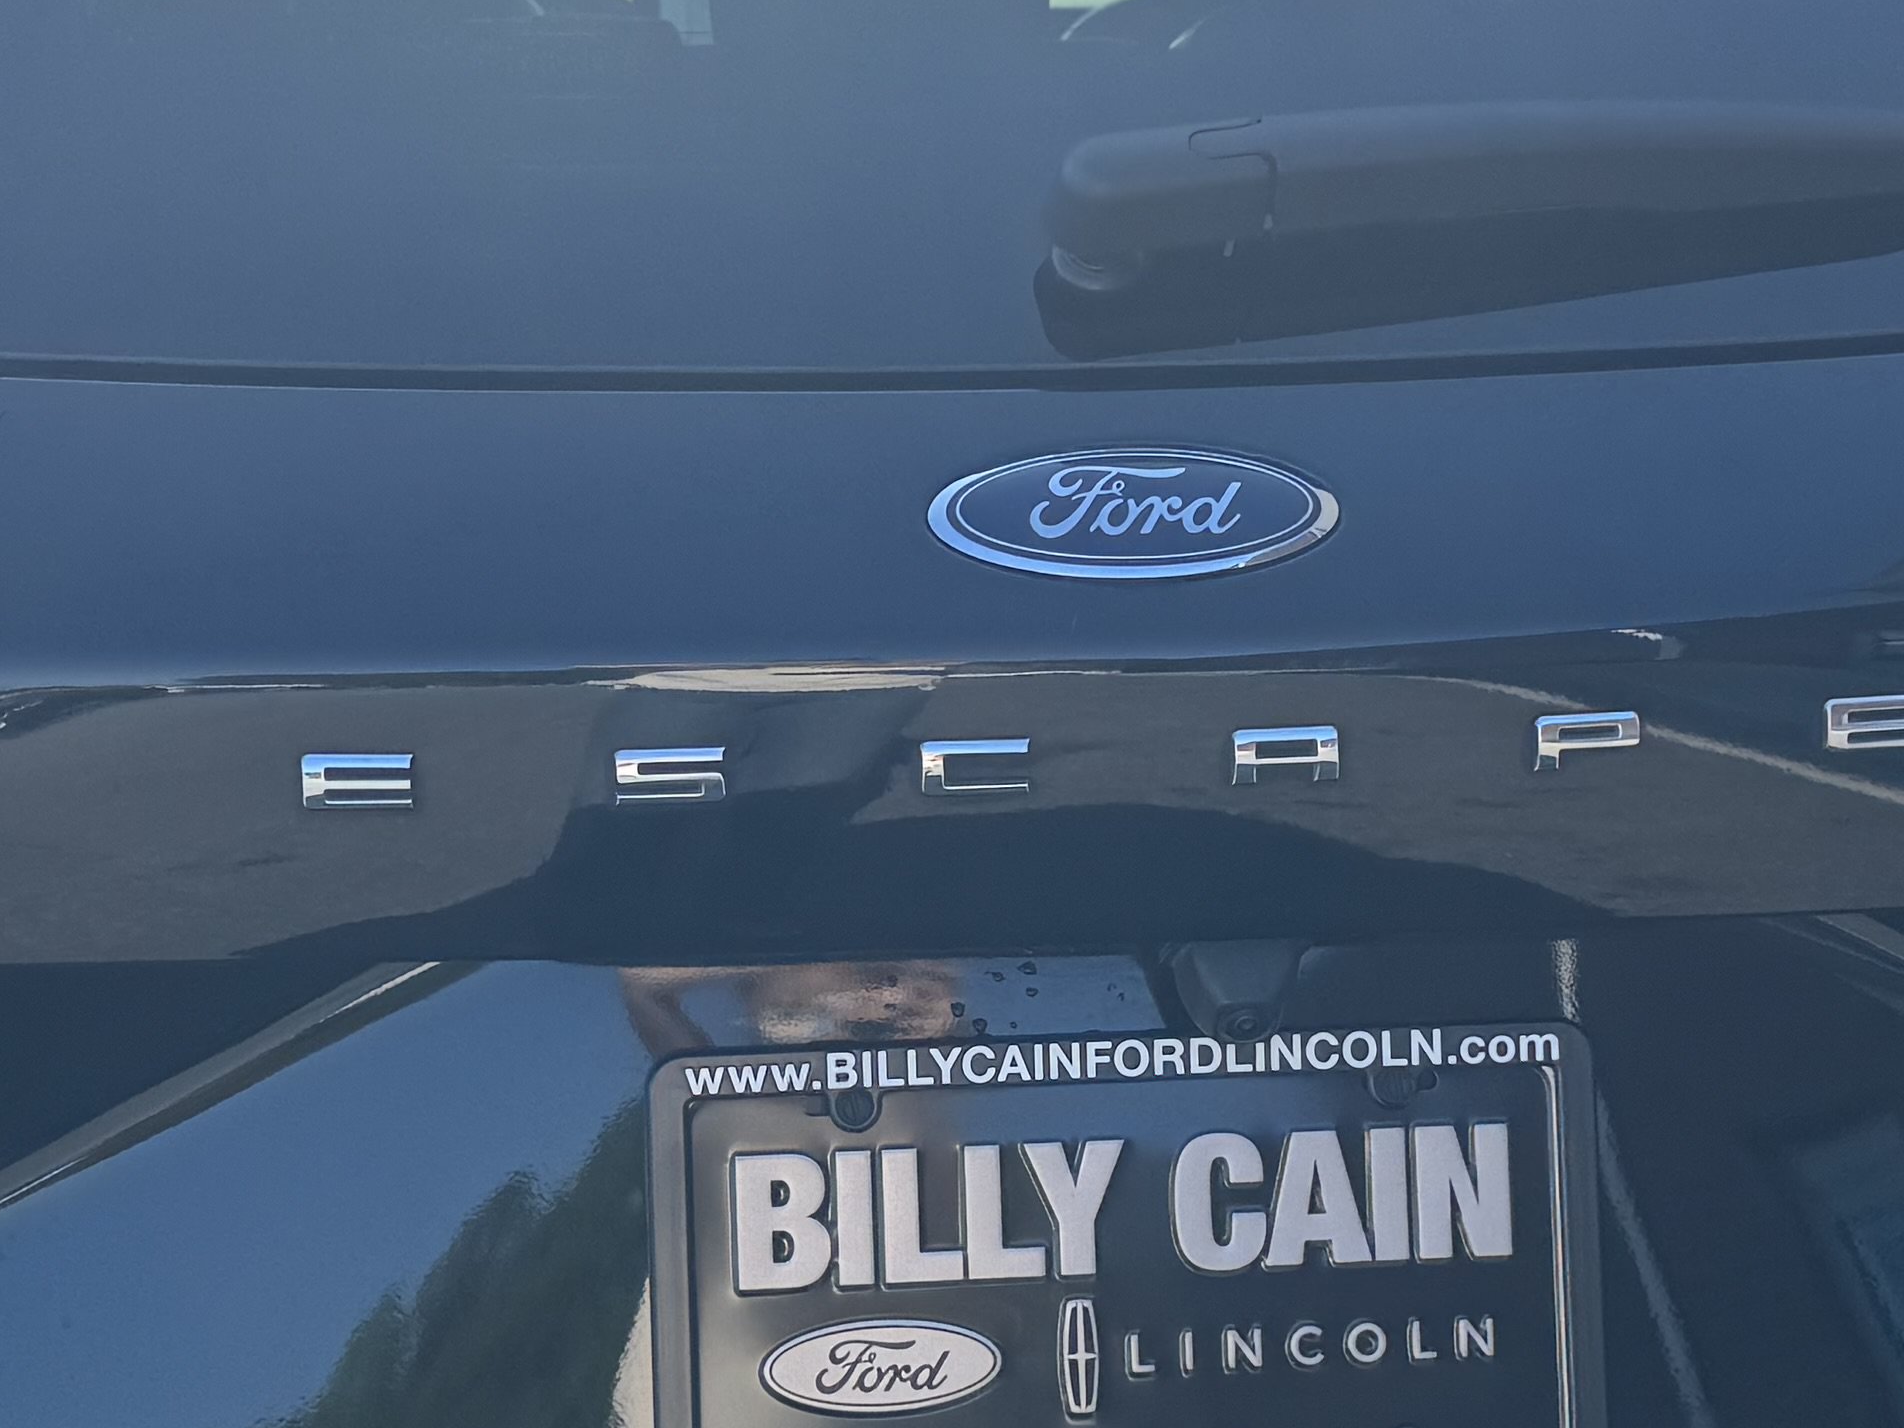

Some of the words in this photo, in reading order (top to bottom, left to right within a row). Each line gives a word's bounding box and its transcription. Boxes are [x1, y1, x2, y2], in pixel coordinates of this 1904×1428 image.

[1029, 465, 1243, 539] Ford
[684, 1027, 1561, 1097] www.BILLYCAINFORDLINCOLN.com
[733, 1137, 1124, 1293] BILLY
[1172, 1121, 1514, 1272] CAIN
[814, 1338, 951, 1395] Ford
[1126, 1314, 1496, 1377] LINCOLN
